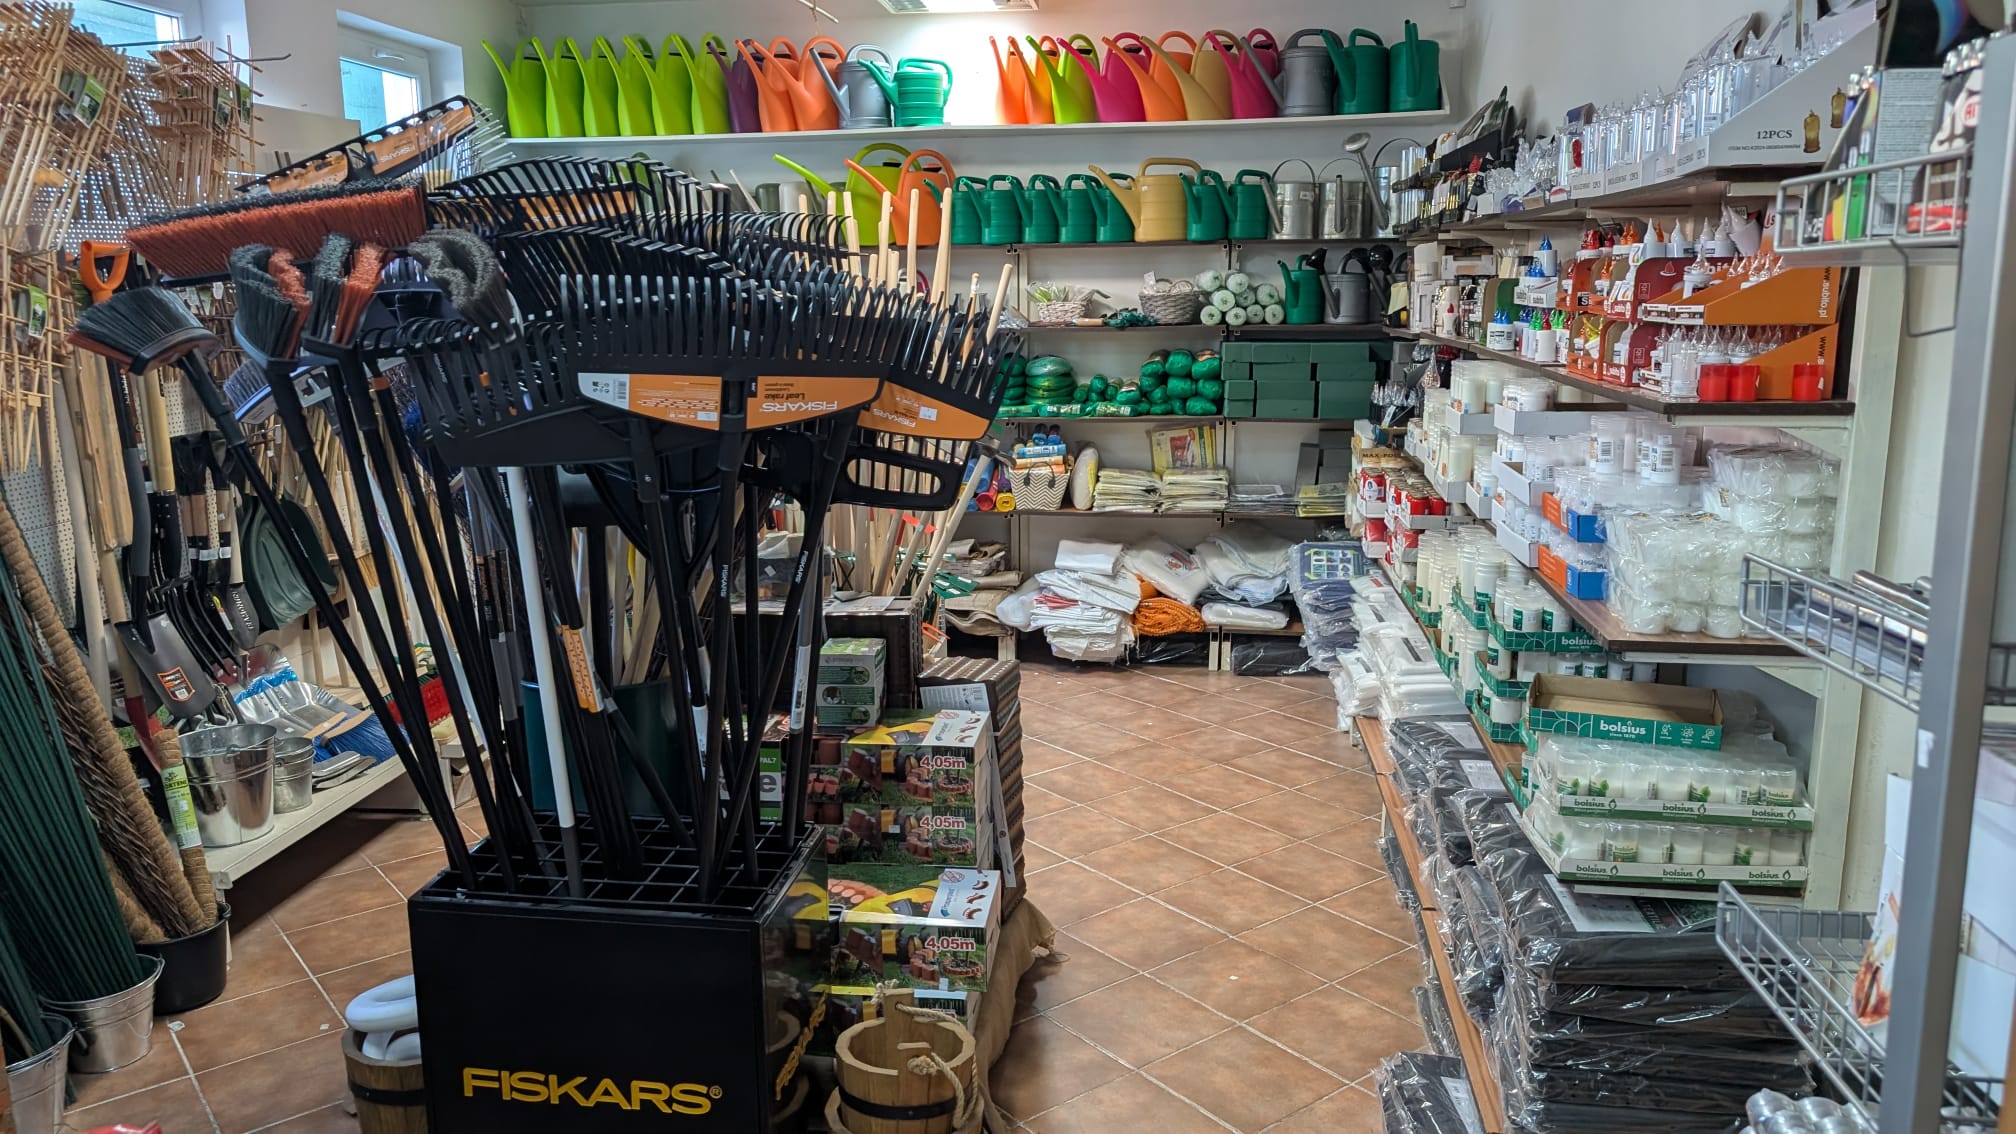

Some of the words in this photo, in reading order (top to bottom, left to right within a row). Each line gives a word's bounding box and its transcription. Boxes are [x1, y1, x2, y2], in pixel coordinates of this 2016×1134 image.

[1757, 130, 1793, 139] 12PCS
[764, 392, 784, 400] rake
[785, 392, 805, 400] Leaf
[761, 399, 838, 412] FISKARS
[795, 549, 809, 585] FISKARS
[719, 563, 729, 598] FISKARS
[1562, 635, 1598, 645] bolsius
[1600, 720, 1646, 735] bolsius
[920, 756, 966, 771] 4,05m
[1574, 798, 1605, 808] bolsius
[1662, 803, 1695, 812] bolsius
[1751, 808, 1784, 817] bolsius
[920, 815, 966, 830] 4,05m
[1576, 864, 1607, 873] bolsius
[1662, 867, 1693, 876] bolsius
[1748, 870, 1779, 879] bolsius
[925, 937, 975, 952] 4,05m
